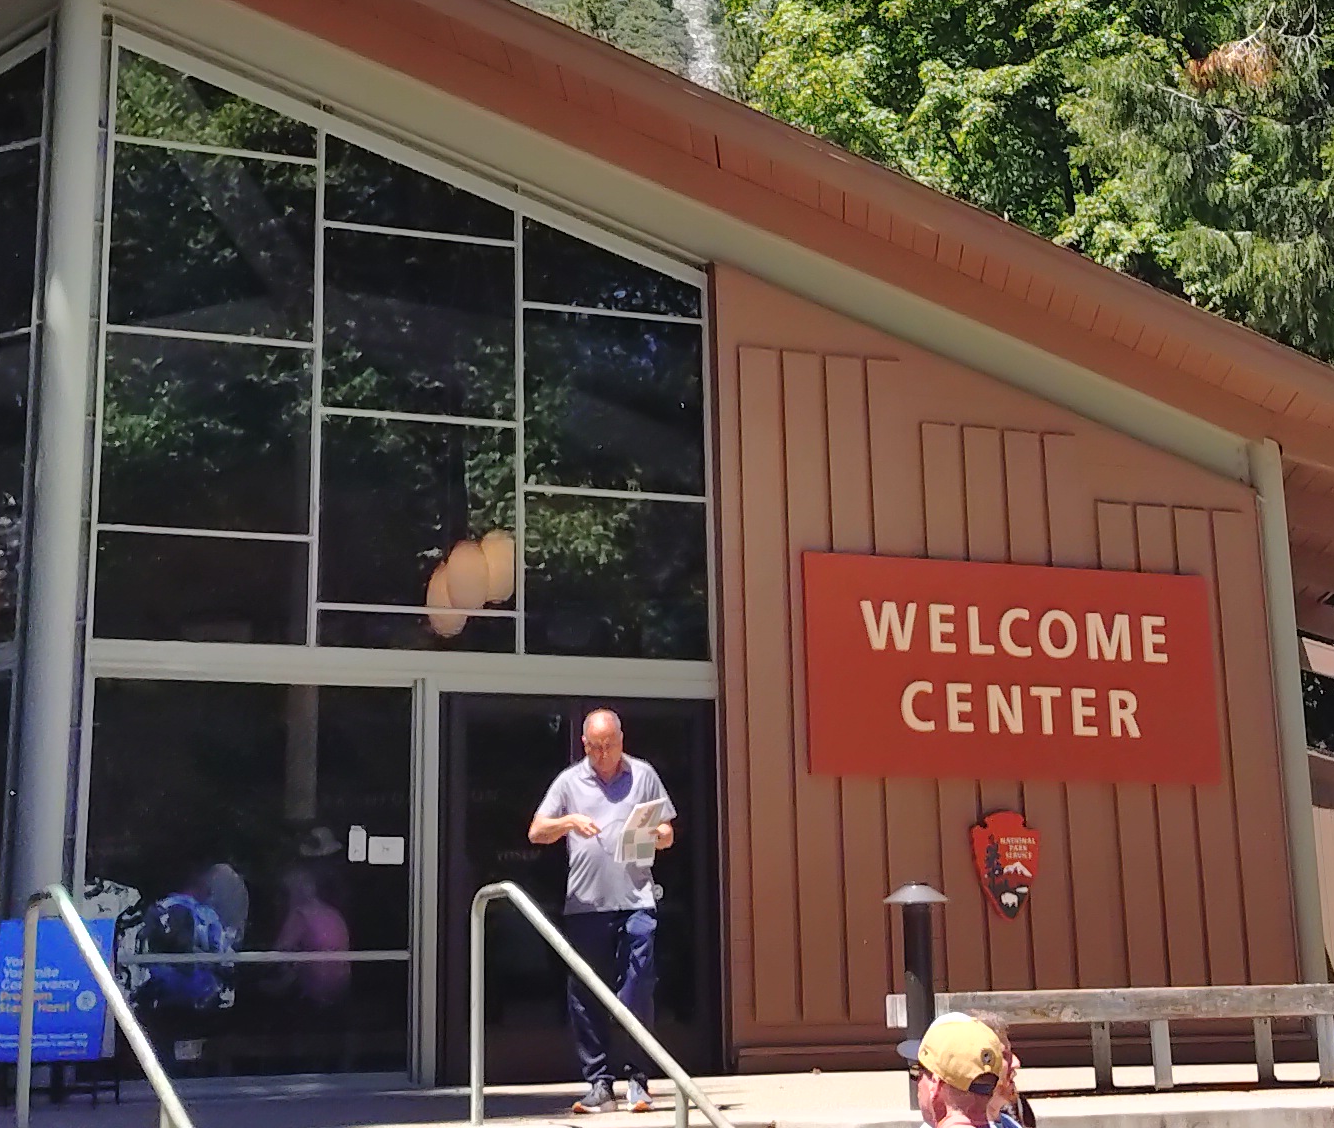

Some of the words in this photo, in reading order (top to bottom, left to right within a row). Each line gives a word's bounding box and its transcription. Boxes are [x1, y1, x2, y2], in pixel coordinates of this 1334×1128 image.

[859, 600, 1169, 663] WELCOME
[900, 679, 1142, 738] CENTER
[999, 837, 1036, 845] NATIONAL
